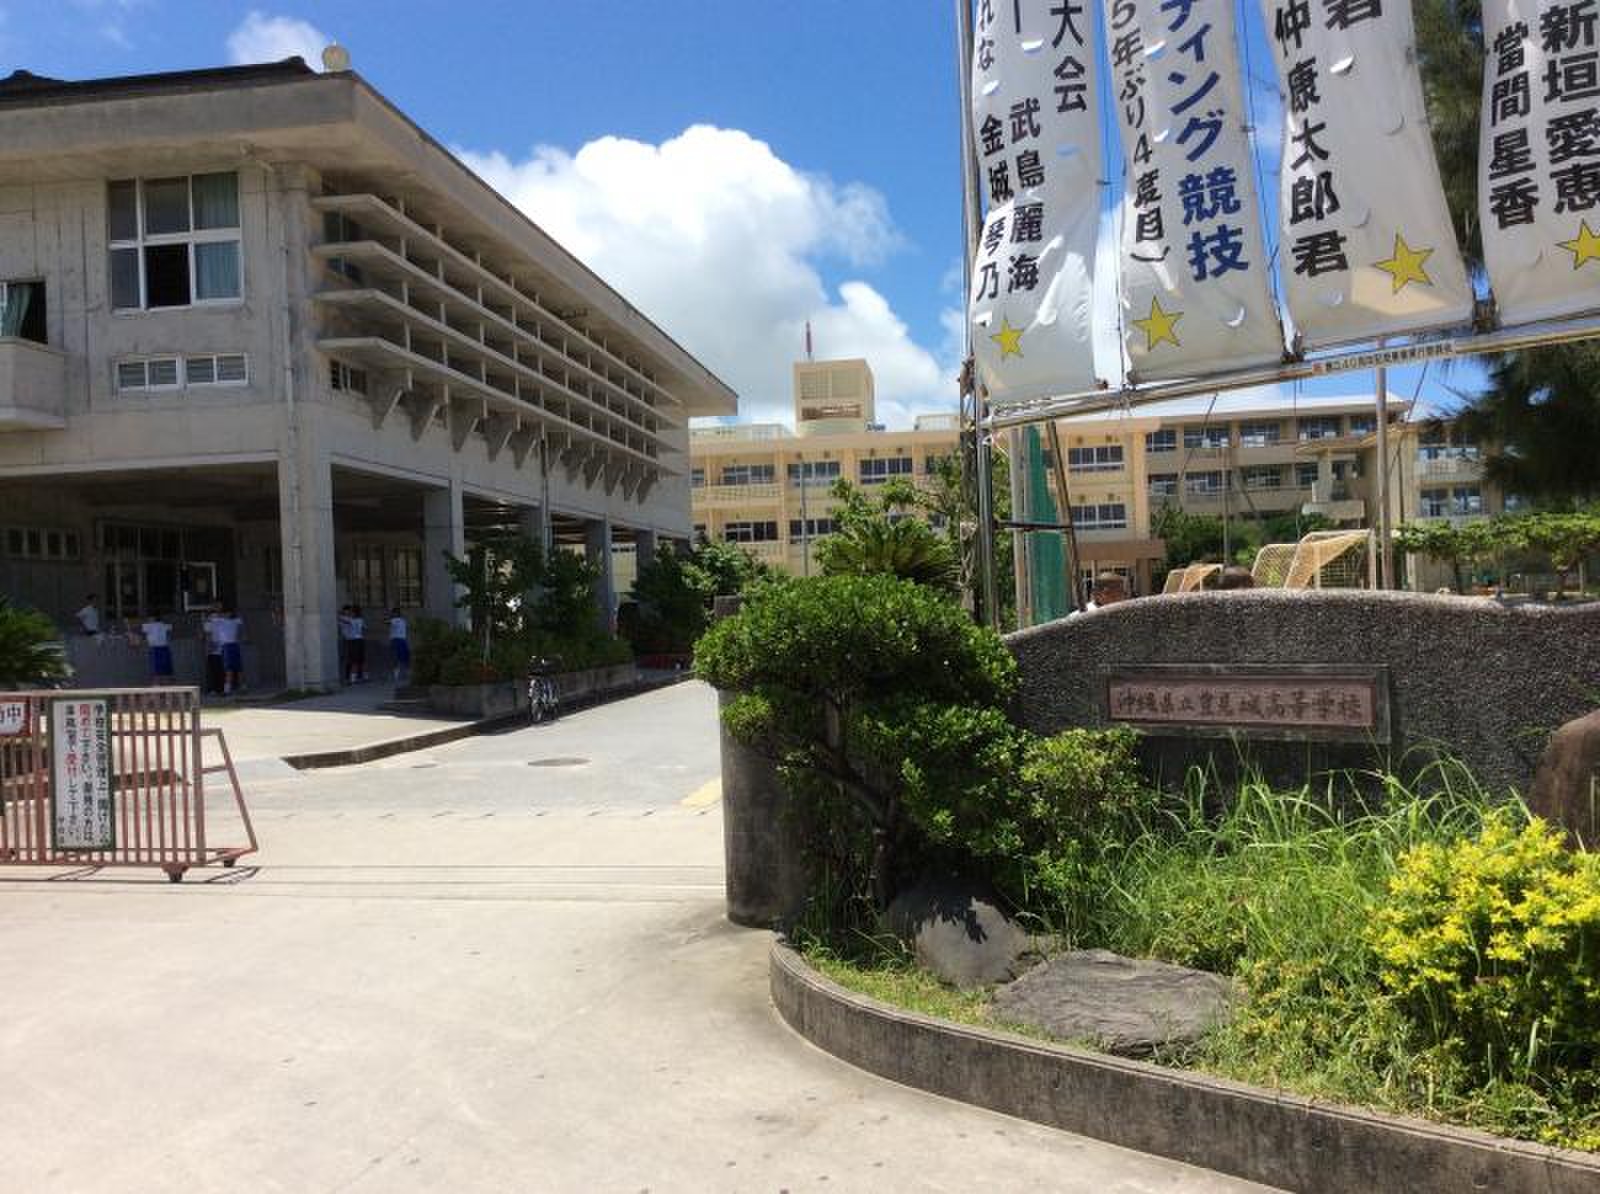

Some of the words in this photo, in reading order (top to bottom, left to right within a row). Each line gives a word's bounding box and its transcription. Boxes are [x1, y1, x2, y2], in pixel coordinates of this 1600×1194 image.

[1050, 0, 1088, 113] 大会
[976, 114, 1014, 301] 金城琴乃
[1007, 97, 1045, 294] 武島麗海
